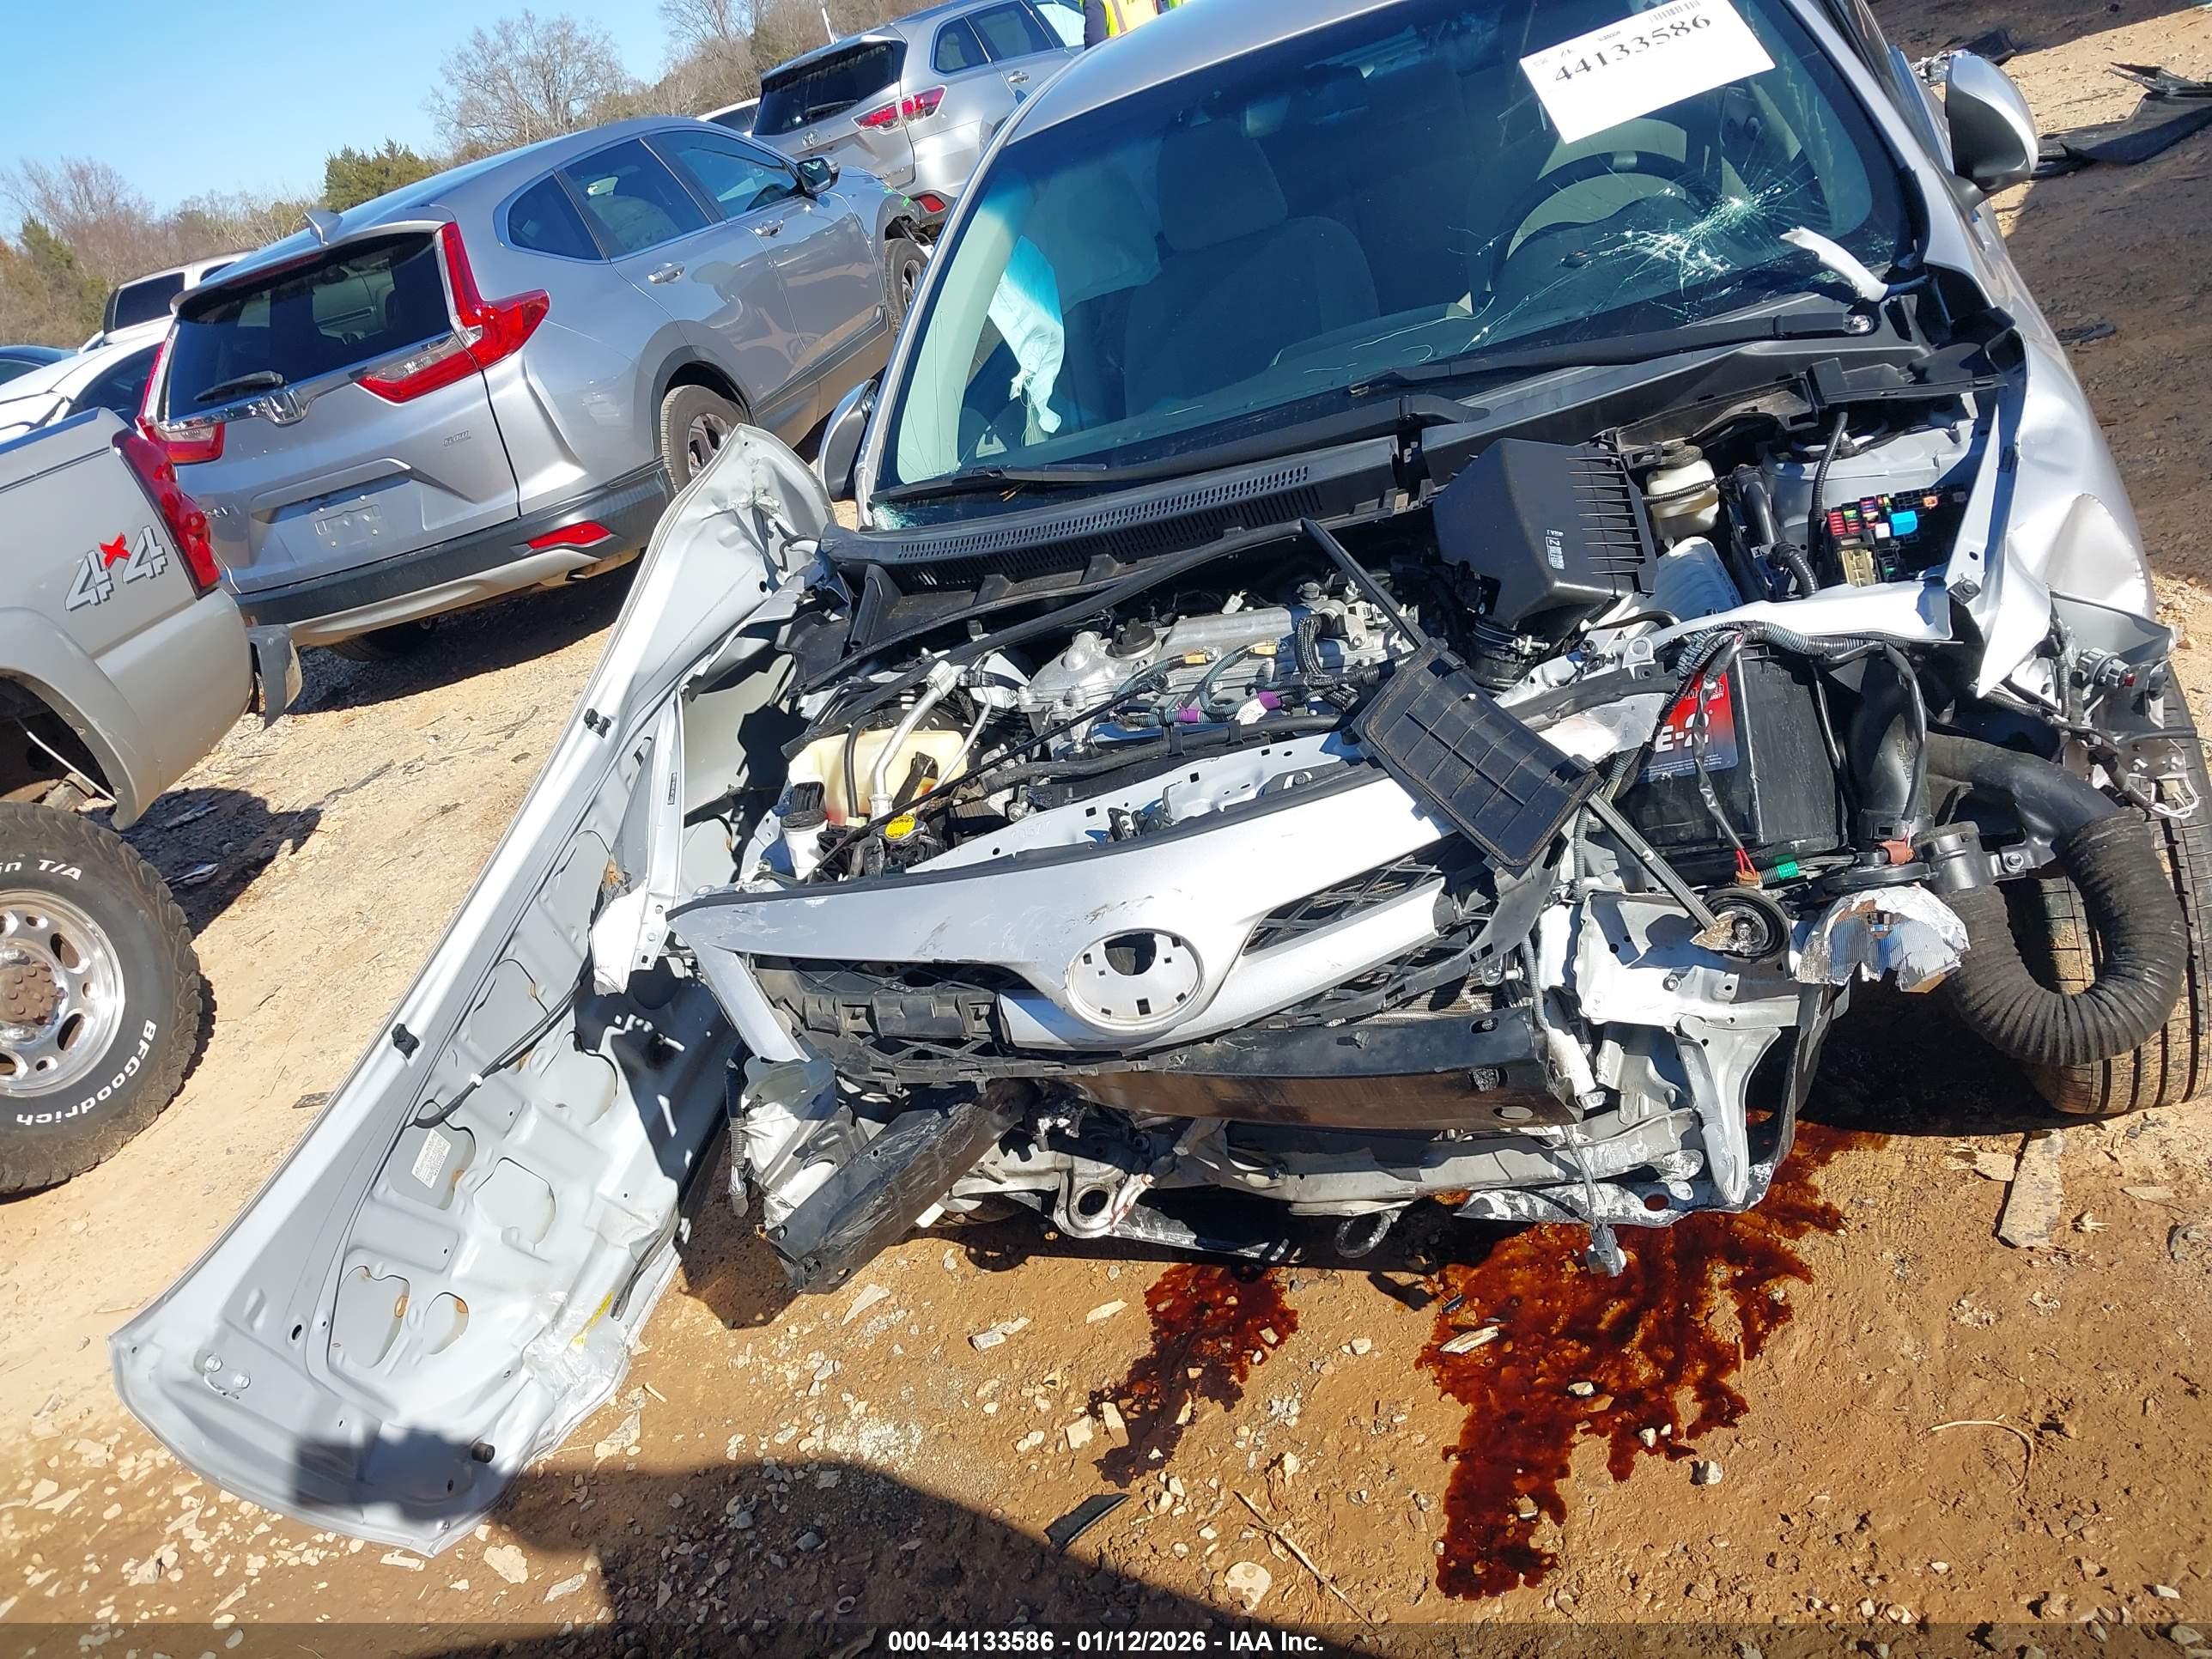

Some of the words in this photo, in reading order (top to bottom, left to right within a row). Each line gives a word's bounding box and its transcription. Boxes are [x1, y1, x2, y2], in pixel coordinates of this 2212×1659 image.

[1554, 14, 1711, 82] 44133586
[38, 859, 82, 881] T/A
[15, 1019, 157, 1126] BFGoodrich
